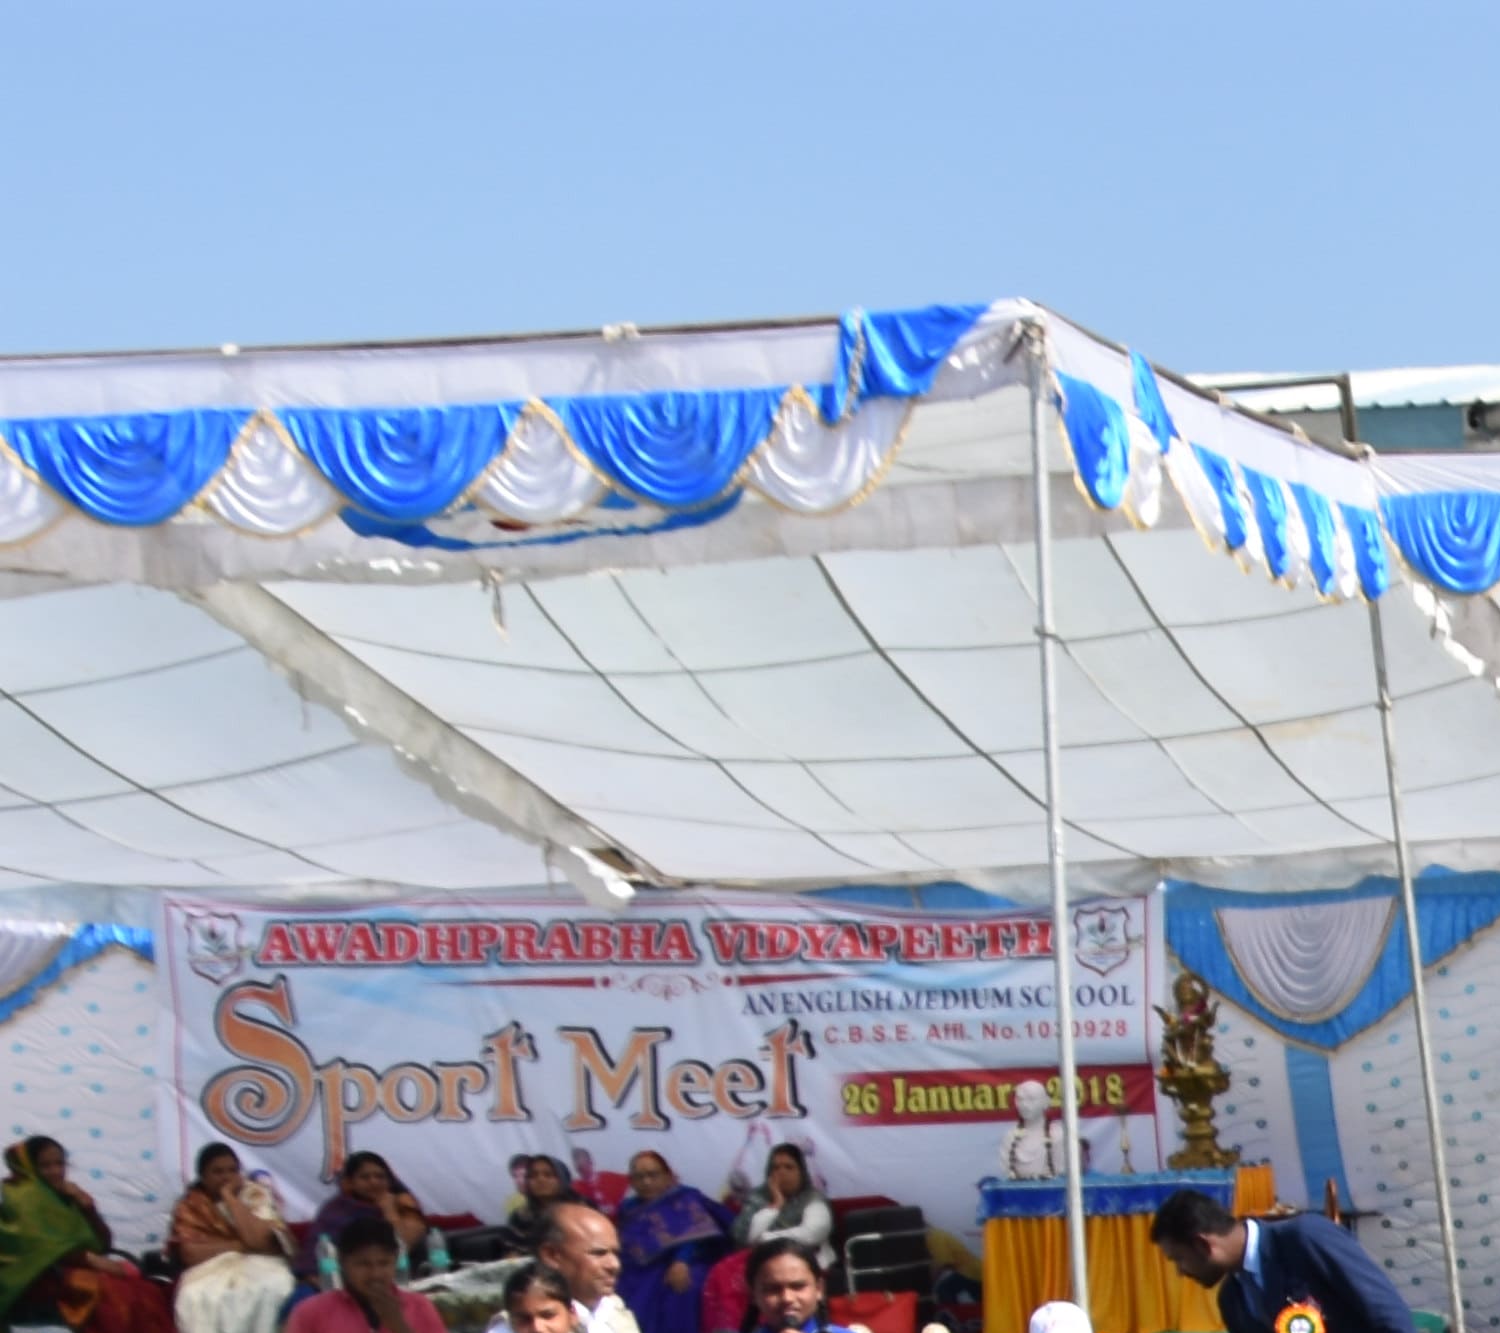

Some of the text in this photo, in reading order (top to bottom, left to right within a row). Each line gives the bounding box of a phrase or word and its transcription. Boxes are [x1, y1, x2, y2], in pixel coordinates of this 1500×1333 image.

[254, 917, 1055, 967] AWADHPRABHA VIDYAPEETH
[896, 986, 1014, 1011] MEDIUM
[1018, 984, 1135, 1008] SCOOL
[202, 974, 817, 1184] Sport Meet
[842, 1082, 881, 1116] 26
[891, 1077, 1018, 1113] Januar
